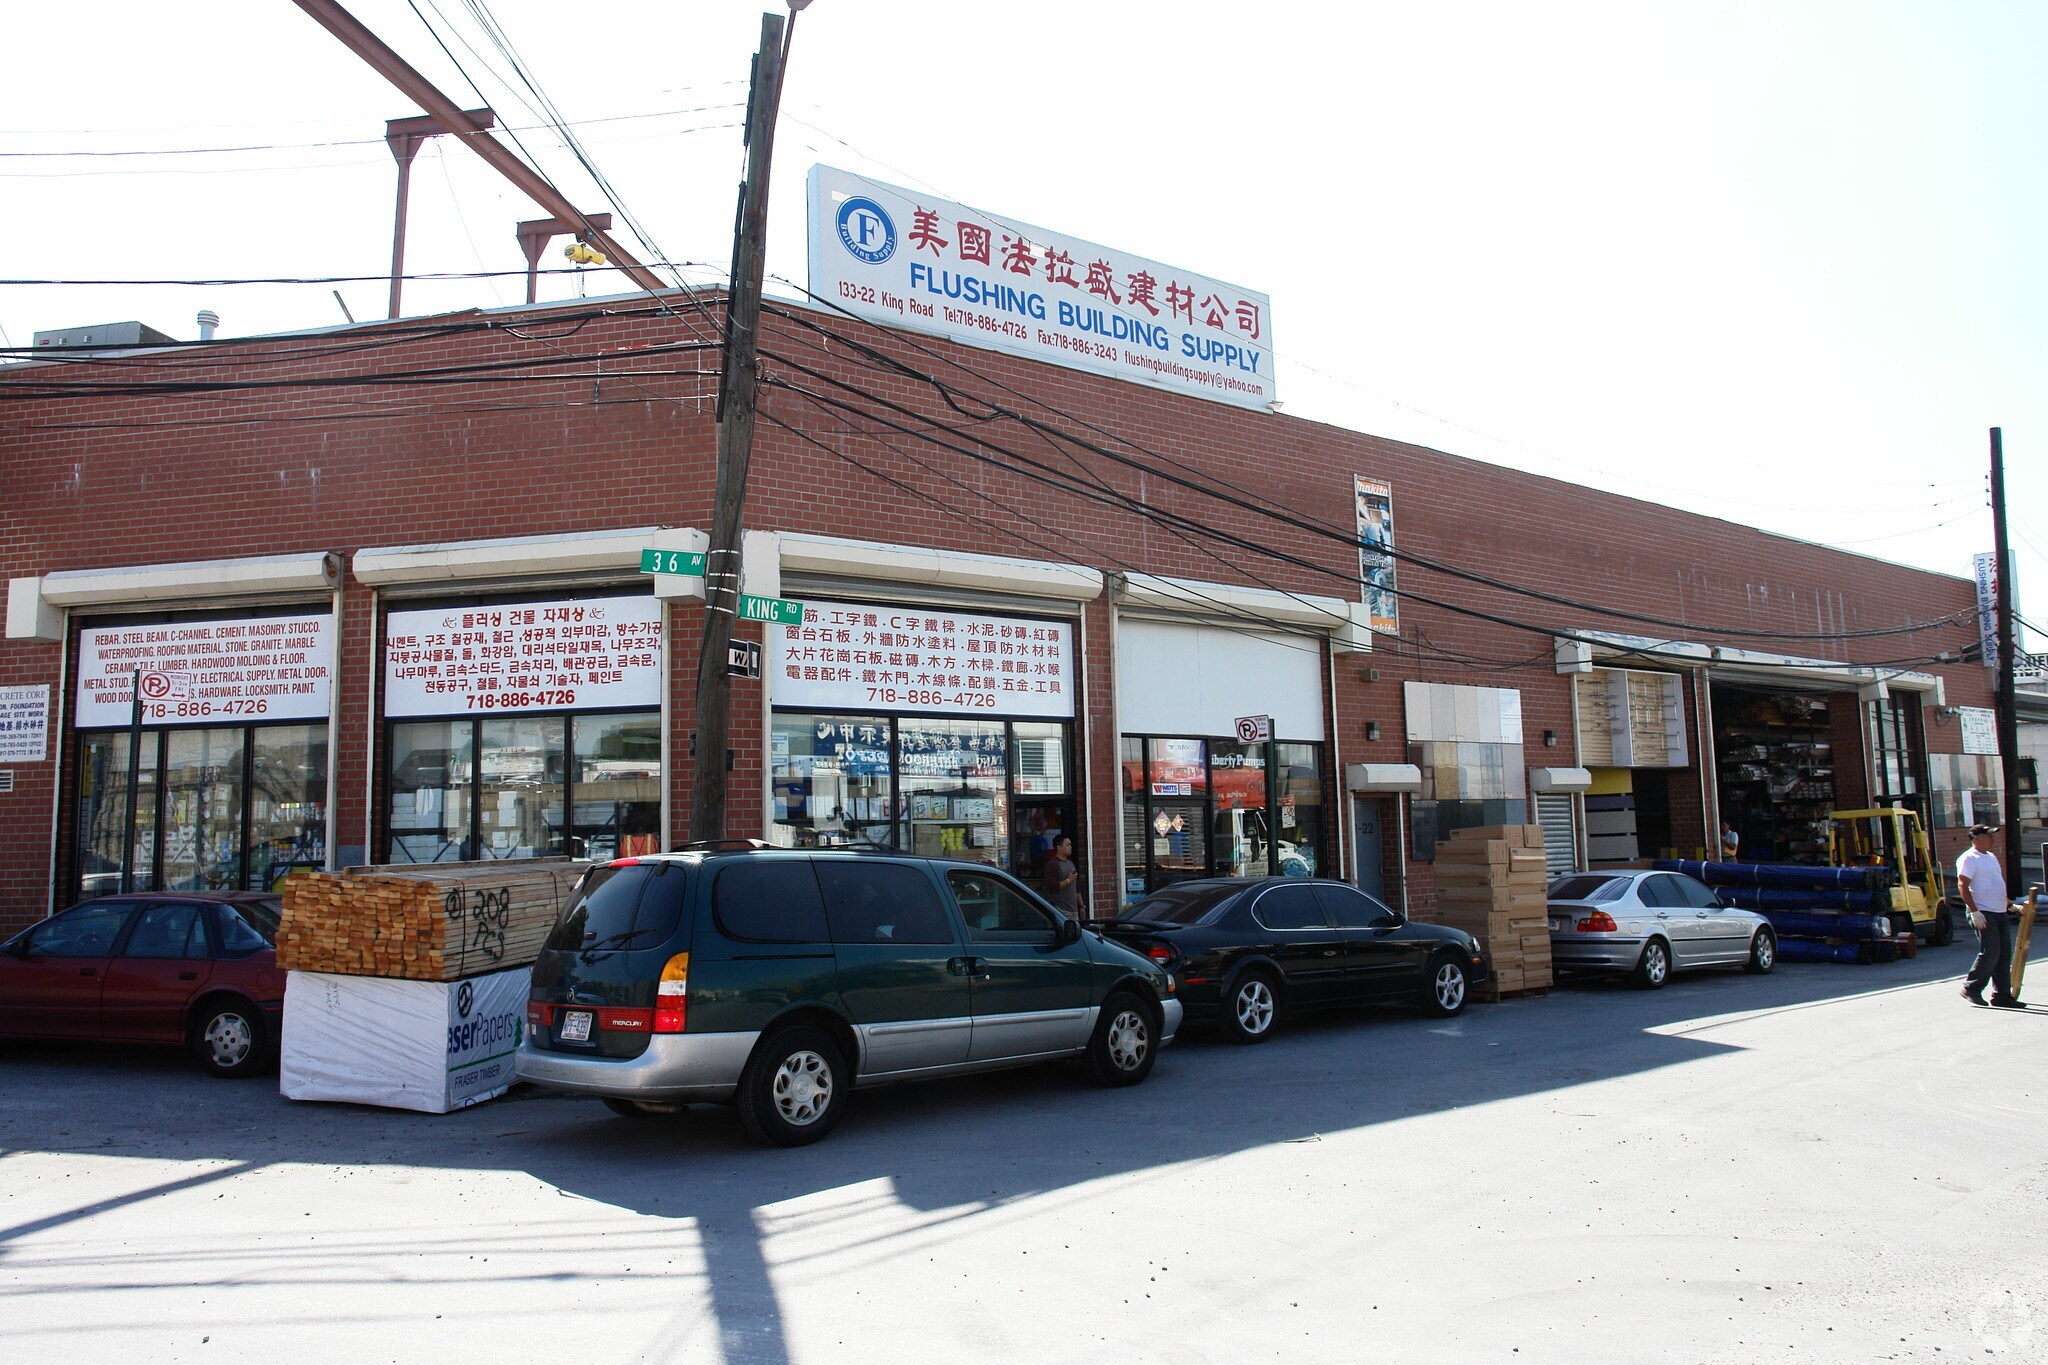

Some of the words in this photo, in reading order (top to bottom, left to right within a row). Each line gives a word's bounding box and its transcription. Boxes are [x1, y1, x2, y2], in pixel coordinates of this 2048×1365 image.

[856, 212, 880, 246] F
[840, 223, 870, 260] Building
[873, 236, 894, 260] Supply
[908, 206, 1260, 340] 美國法拉盛建材公司
[910, 263, 1046, 320] FLUSHING
[1059, 302, 1169, 351] BUILDING
[1182, 334, 1260, 373] SUPPLY
[838, 281, 876, 304] 133-22
[881, 290, 904, 314] King
[909, 295, 934, 318] Road
[943, 306, 1028, 340] Tel:718-886-4726
[1038, 330, 1118, 362] Fax:718-886-3243
[1124, 351, 1264, 396] flushingbuildingsupply@yahoo.com
[691, 556, 702, 566] AV
[1978, 558, 1988, 594] FLUSHING
[462, 612, 501, 628] 플러싱
[509, 610, 535, 625] 건물
[543, 607, 585, 623] 자재상
[746, 598, 778, 620] KING
[786, 603, 797, 614] RD
[95, 634, 122, 645] REBAR.
[123, 633, 146, 644] STEEL
[146, 631, 168, 642] BEAM.
[171, 629, 215, 641] C-CHANNEL.
[216, 626, 246, 638] CEMENT.
[249, 624, 286, 636] MASONRY.
[289, 622, 320, 634] STUCCO.
[385, 636, 420, 651] 시멘트,
[425, 634, 445, 647] 구조
[561, 625, 610, 639] 외부마감,
[617, 621, 662, 636] 방수가공
[98, 646, 156, 660] WATERPROOFING.
[157, 645, 186, 656] ROOFING
[187, 643, 223, 654] MATERIAL.
[226, 641, 250, 652] STONE.
[251, 639, 284, 651] GRANITE.
[285, 637, 316, 649] MARBLE.
[105, 662, 137, 674] CERAMIC
[157, 659, 189, 673] LUMBER.
[192, 657, 235, 669] HARDWOOD
[237, 655, 271, 667] MOLDING
[272, 654, 279, 665] &
[280, 653, 307, 664] FLOOR.
[396, 666, 441, 679] 나무마루,
[446, 662, 504, 677] 금속스타드,
[509, 659, 557, 673] 금속처리,
[563, 656, 612, 670] 배관공급,
[617, 654, 656, 667] 금속문,
[84, 679, 107, 689] METAL
[109, 677, 129, 688] STUD.
[201, 671, 244, 683] ELECTRICAL
[247, 669, 275, 681] SUPPLY.
[278, 668, 302, 679] METAL
[305, 667, 329, 678] DOOR.
[425, 679, 471, 693] 전동공구,
[477, 677, 501, 690] 철물,
[506, 675, 539, 688] 자물쇠
[546, 673, 583, 686] 기술자,
[589, 671, 622, 684] 페인트
[95, 692, 117, 703] WOOD
[118, 691, 134, 703] DOO
[199, 686, 244, 698] HARDWARE.
[245, 684, 291, 696] LOCKSMITH.
[292, 682, 315, 694] PAINT.
[467, 689, 575, 709] 718-886-4726
[866, 688, 996, 707] 718-886-4726
[142, 700, 267, 718] 718-886-4726
[1236, 754, 1266, 768] Pumps
[474, 887, 509, 928] 208
[473, 921, 504, 958] PCS
[454, 1072, 478, 1089] FRASER
[479, 1064, 500, 1081] TIMBER
